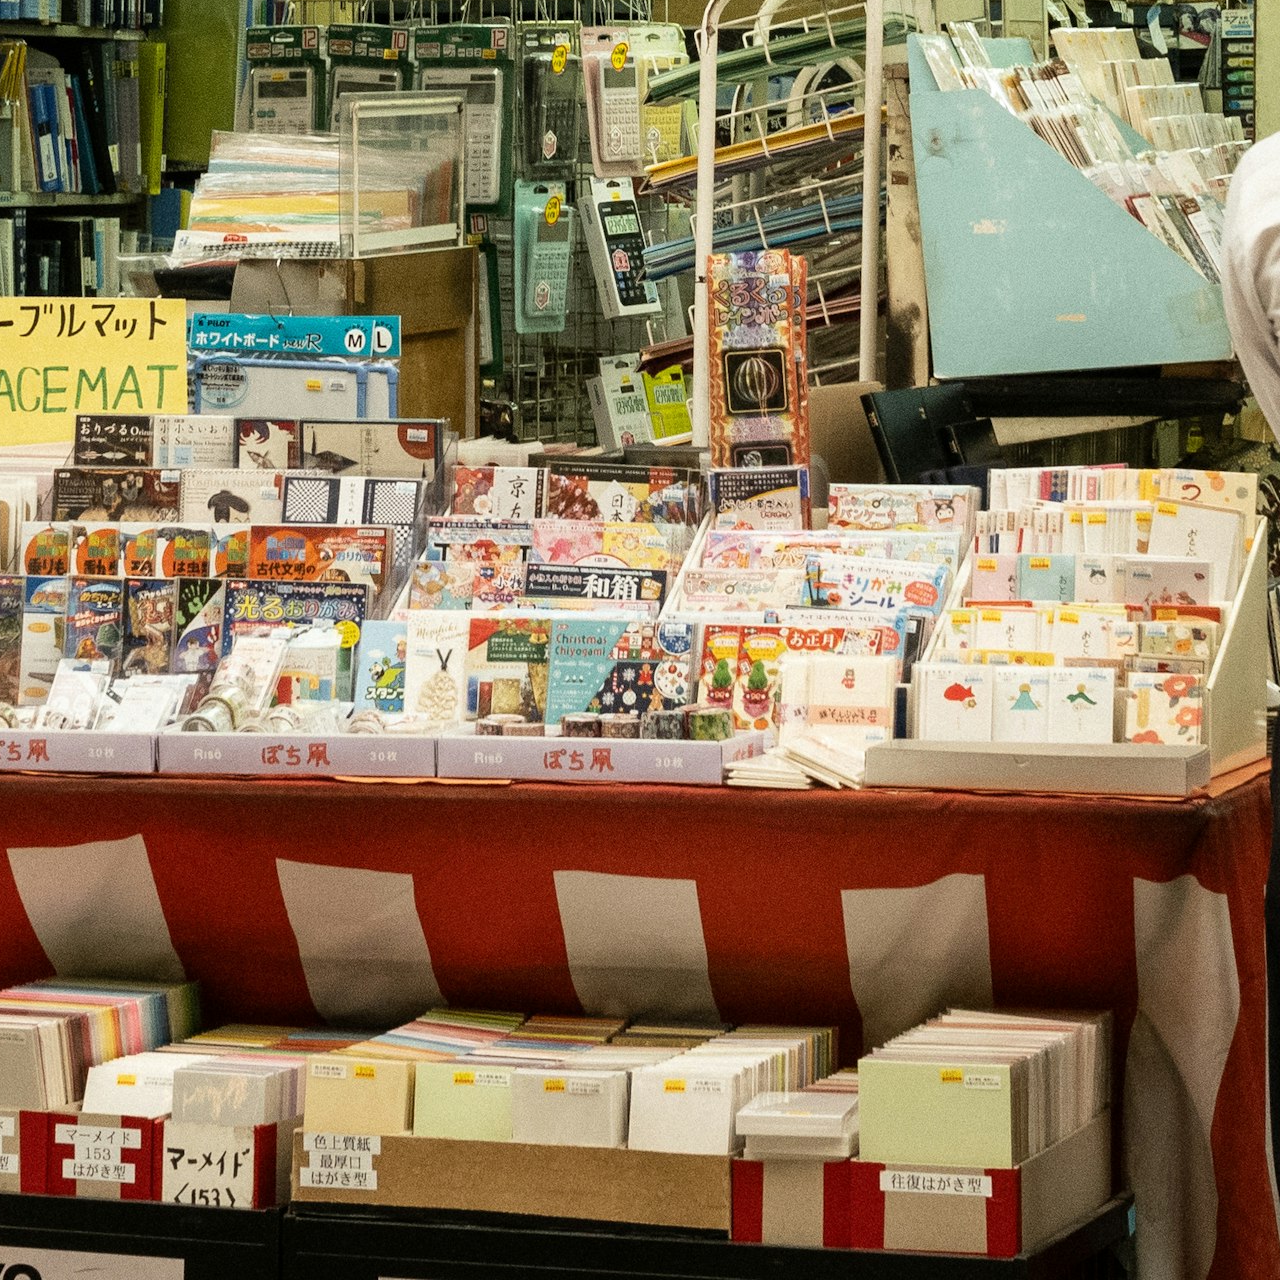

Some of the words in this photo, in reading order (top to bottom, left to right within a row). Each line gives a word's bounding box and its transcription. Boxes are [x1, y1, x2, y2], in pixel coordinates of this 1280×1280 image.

[303, 30, 317, 48] 12
[392, 32, 407, 49] 10
[493, 30, 506, 48] 12
[713, 277, 787, 307] くるくる
[196, 332, 279, 348] ホワイトボード
[348, 335, 362, 348] M
[377, 331, 387, 348] L
[80, 423, 127, 435] おりづる
[611, 494, 624, 522] 日本
[266, 549, 306, 561] MOVE
[27, 558, 66, 575] 乗りも
[256, 563, 316, 576] 古代文明の
[581, 574, 640, 600] 和箱
[842, 574, 903, 594] きりがみ
[848, 591, 896, 607] シール
[235, 596, 358, 621] 光るおりがみ
[555, 635, 608, 645] Christmas
[790, 632, 837, 647] お正月
[555, 646, 606, 657] Chiyogami
[66, 1128, 132, 1144] マーメイド
[313, 1134, 371, 1152] 色上質紙
[85, 1147, 111, 1160] 153
[320, 1154, 362, 1169] 最厚口
[167, 1147, 251, 1178] マーメイド
[73, 1164, 127, 1180] はがき型
[311, 1171, 368, 1186] はがき型
[890, 1173, 983, 1193] 往復はがき型
